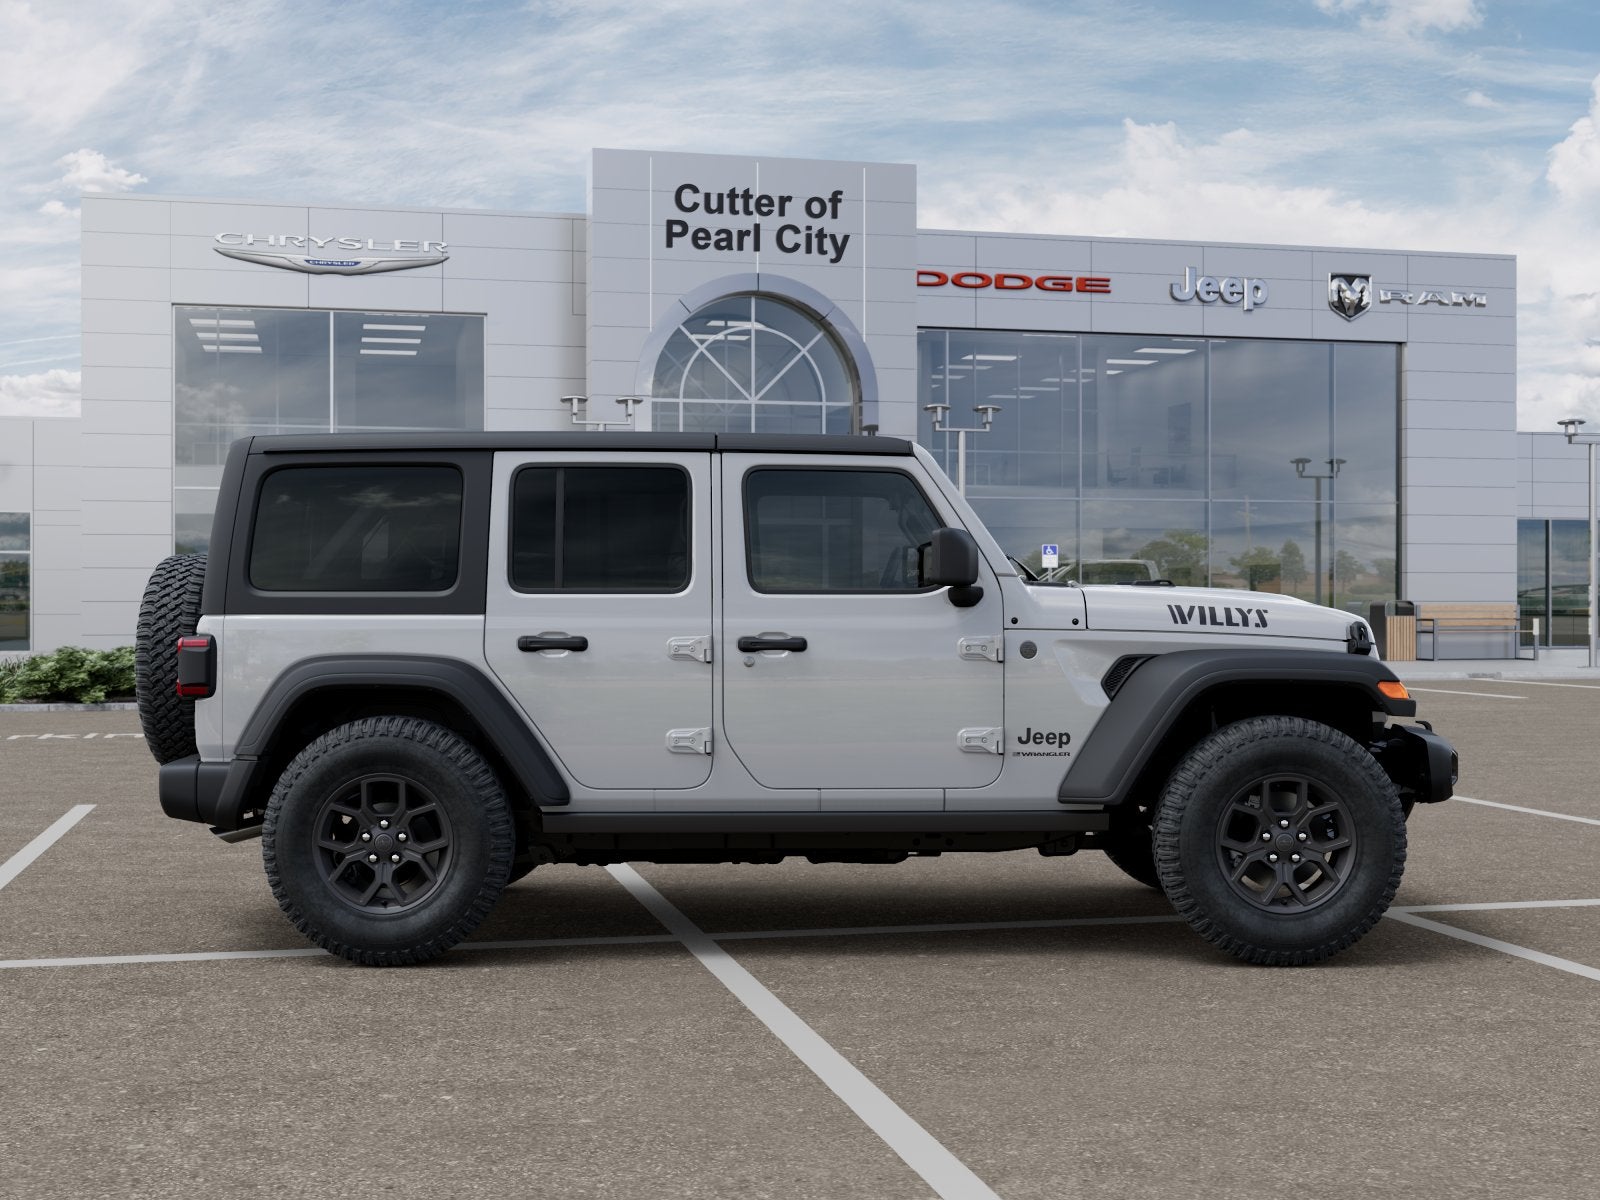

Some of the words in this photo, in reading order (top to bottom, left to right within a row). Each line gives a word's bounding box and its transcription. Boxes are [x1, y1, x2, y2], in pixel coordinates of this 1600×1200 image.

[674, 183, 793, 217] Cutter
[804, 190, 844, 219] of
[214, 232, 449, 253] CHRYSLER
[665, 219, 761, 252] Pearl
[775, 224, 851, 264] City
[916, 270, 1112, 294] DODGE
[1169, 265, 1269, 312] Jeep
[1379, 288, 1488, 308] RAM
[1167, 604, 1269, 628] WILLYS
[1017, 727, 1071, 749] Jeep
